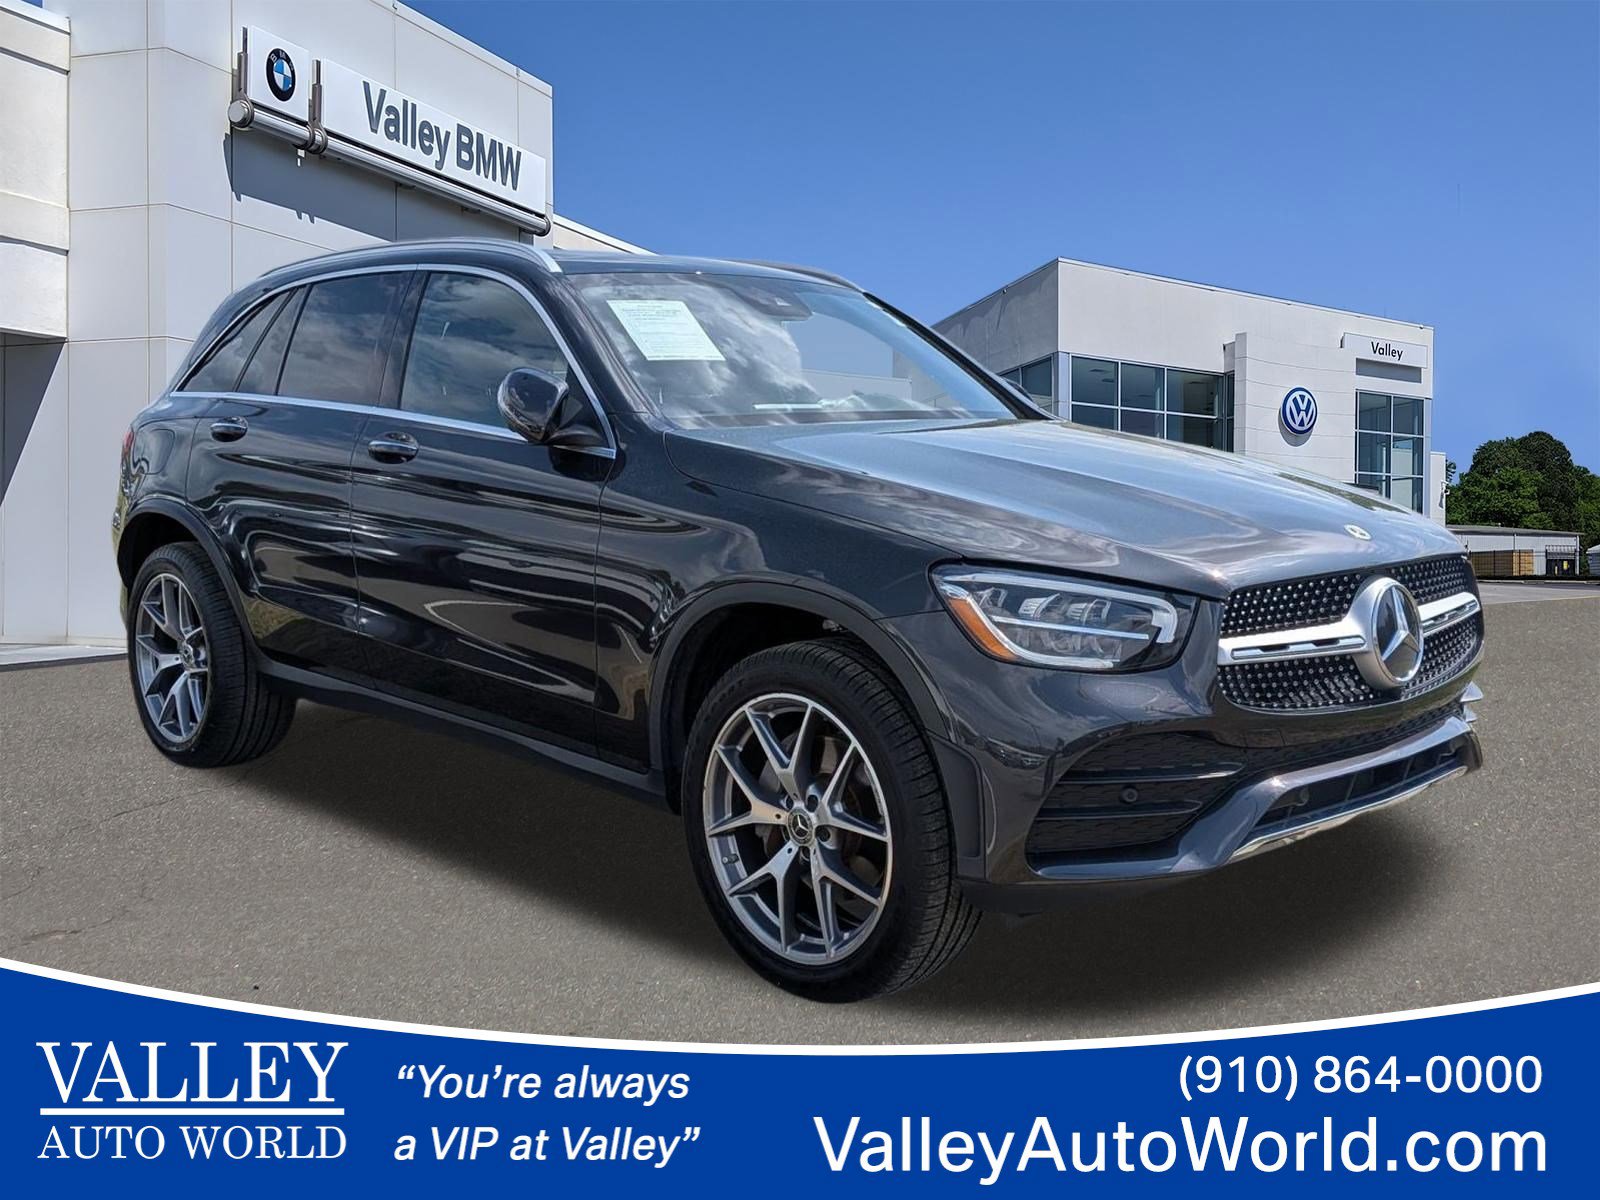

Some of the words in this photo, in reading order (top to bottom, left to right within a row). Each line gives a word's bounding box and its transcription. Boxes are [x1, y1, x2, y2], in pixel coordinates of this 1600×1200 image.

[362, 80, 451, 171] Valley
[455, 122, 522, 191] BMW
[1371, 341, 1404, 361] Valley
